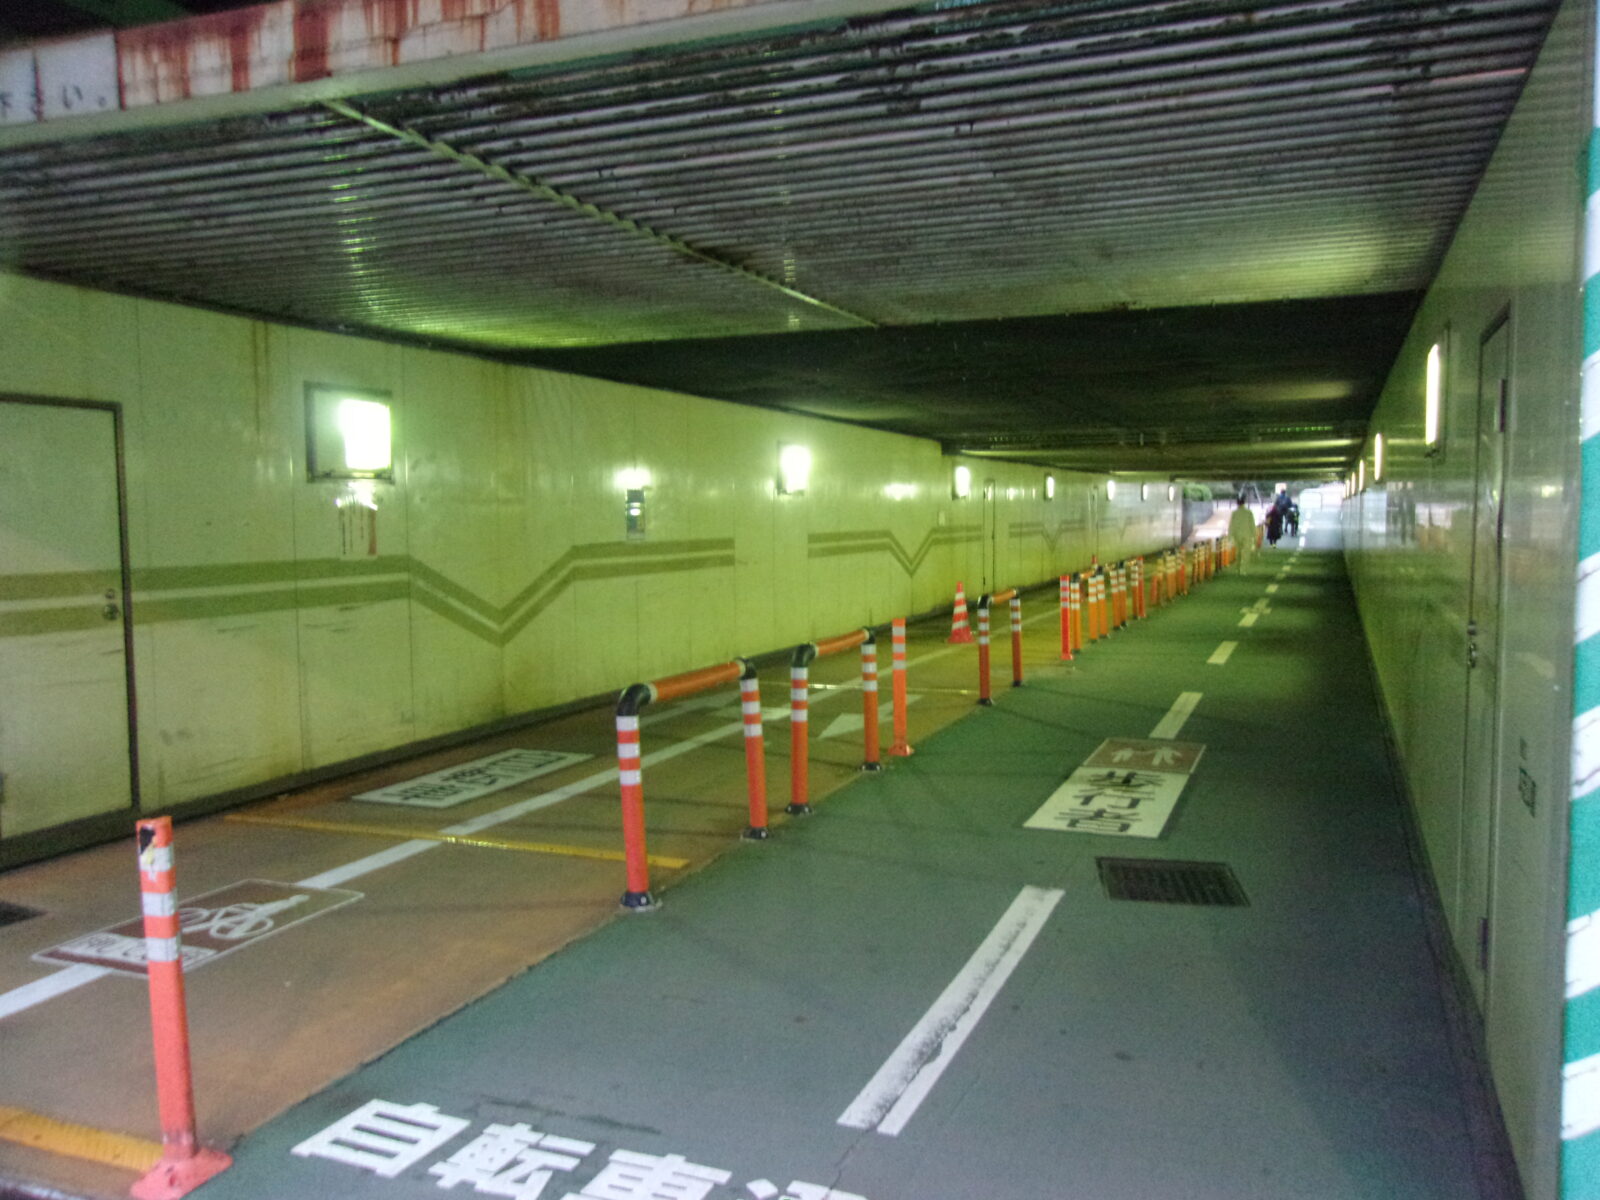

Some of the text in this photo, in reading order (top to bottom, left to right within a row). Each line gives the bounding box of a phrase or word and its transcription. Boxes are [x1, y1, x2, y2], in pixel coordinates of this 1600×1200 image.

[1053, 771, 1163, 832] 歩行者
[291, 1098, 871, 1200] 自転車
